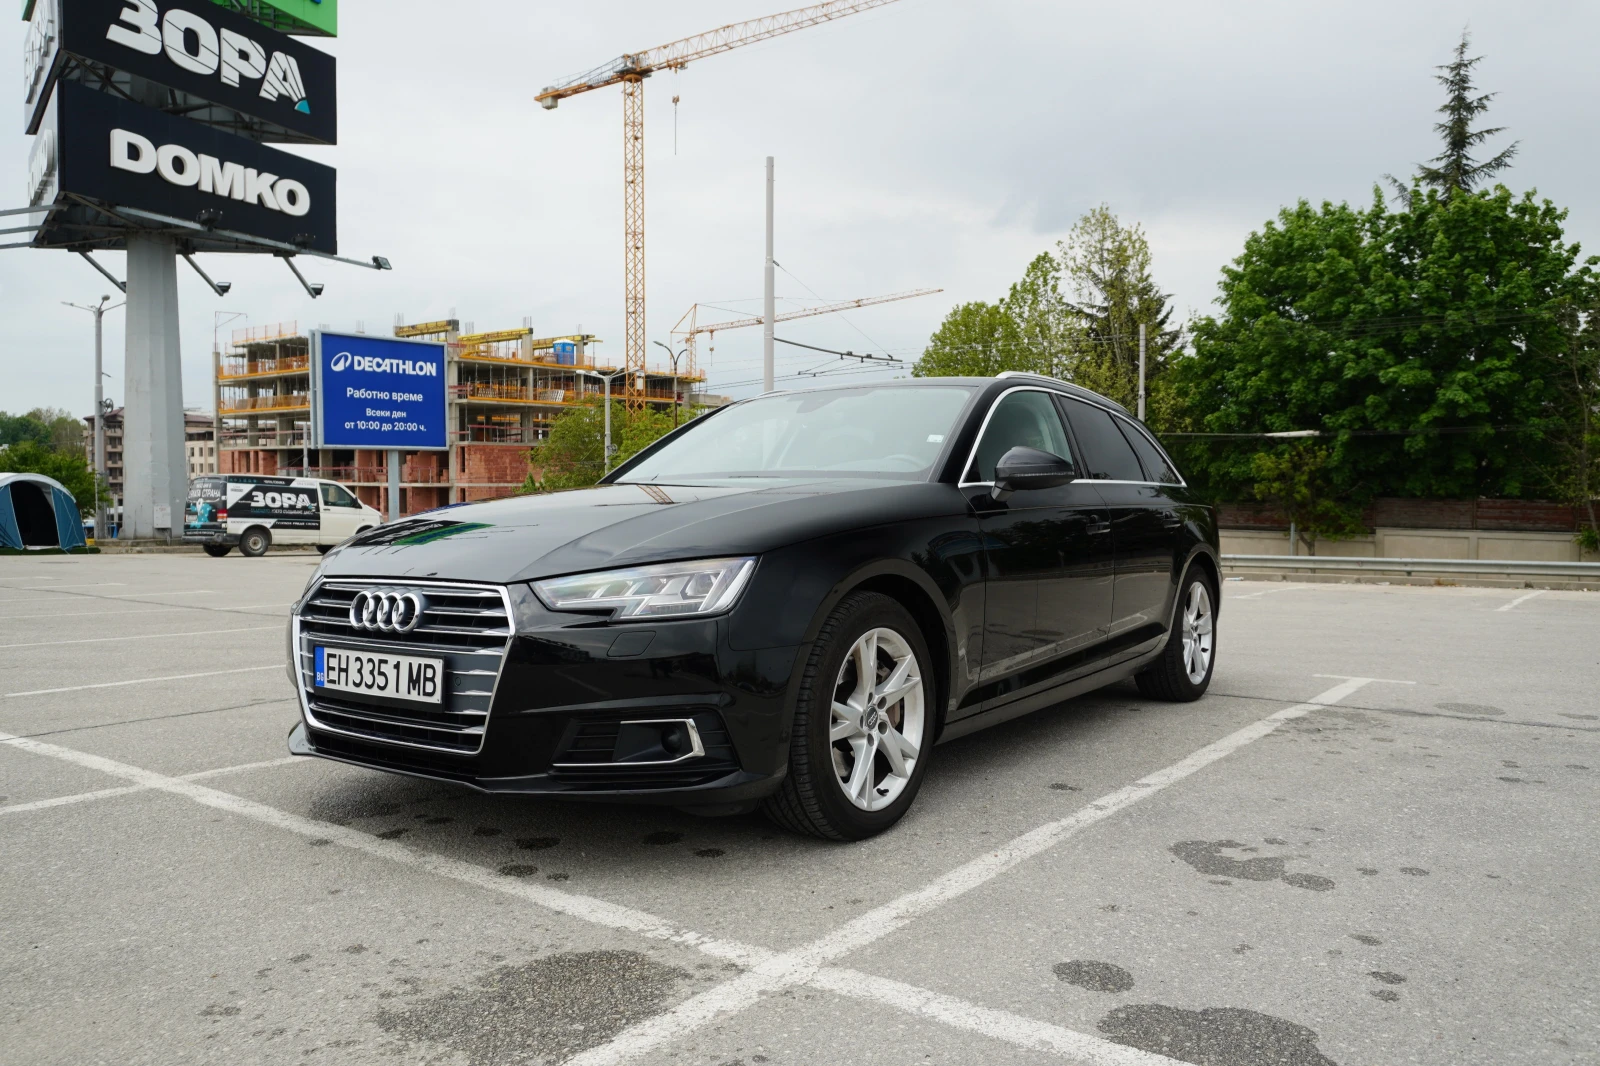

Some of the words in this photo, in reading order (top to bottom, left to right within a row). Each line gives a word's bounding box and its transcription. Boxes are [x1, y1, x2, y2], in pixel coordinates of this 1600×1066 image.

[106, 0, 310, 114] ЗОРА
[110, 128, 310, 216] DOMKO
[353, 355, 437, 376] DECATHLON
[346, 387, 390, 400] Работно
[392, 392, 423, 402] време
[366, 408, 390, 418] Всеки
[356, 421, 380, 430] 10:00
[394, 422, 417, 431] 20:00
[250, 491, 313, 509] ЗОРА
[326, 653, 349, 686] EH
[352, 656, 400, 694] 3351
[407, 662, 437, 697] MB
